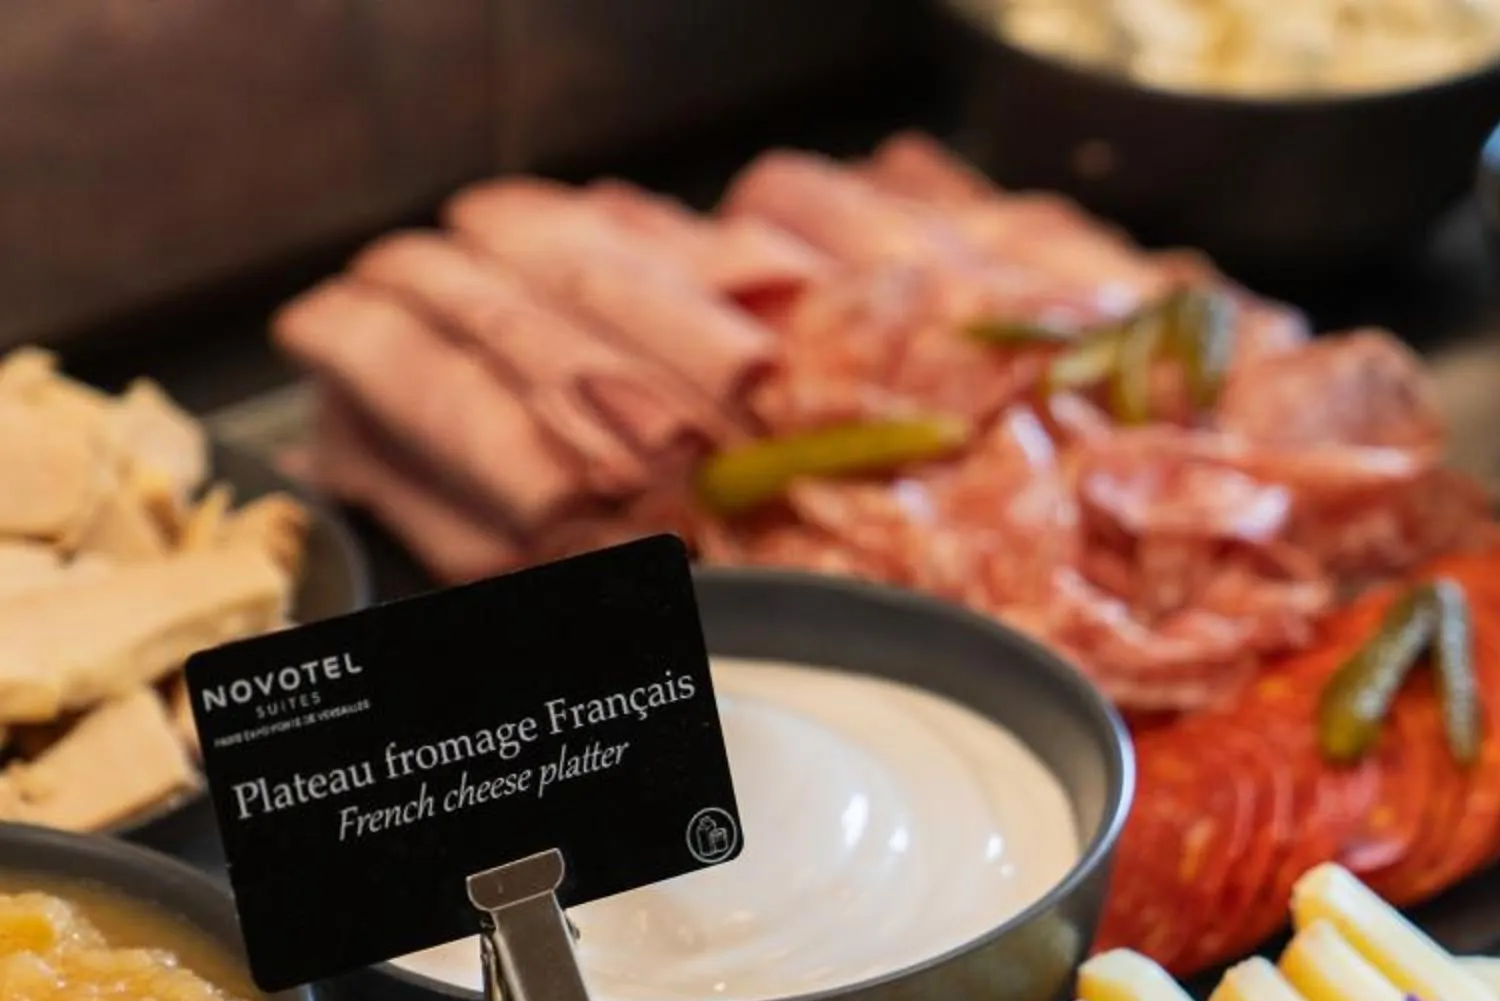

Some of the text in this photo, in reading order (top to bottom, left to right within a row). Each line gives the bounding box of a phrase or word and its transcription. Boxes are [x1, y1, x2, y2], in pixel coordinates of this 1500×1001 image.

[202, 653, 363, 713] NOVOTEL
[255, 691, 321, 719] SUITES
[232, 669, 696, 820] Plateau fromage Français
[338, 741, 631, 841] French cheese platter
